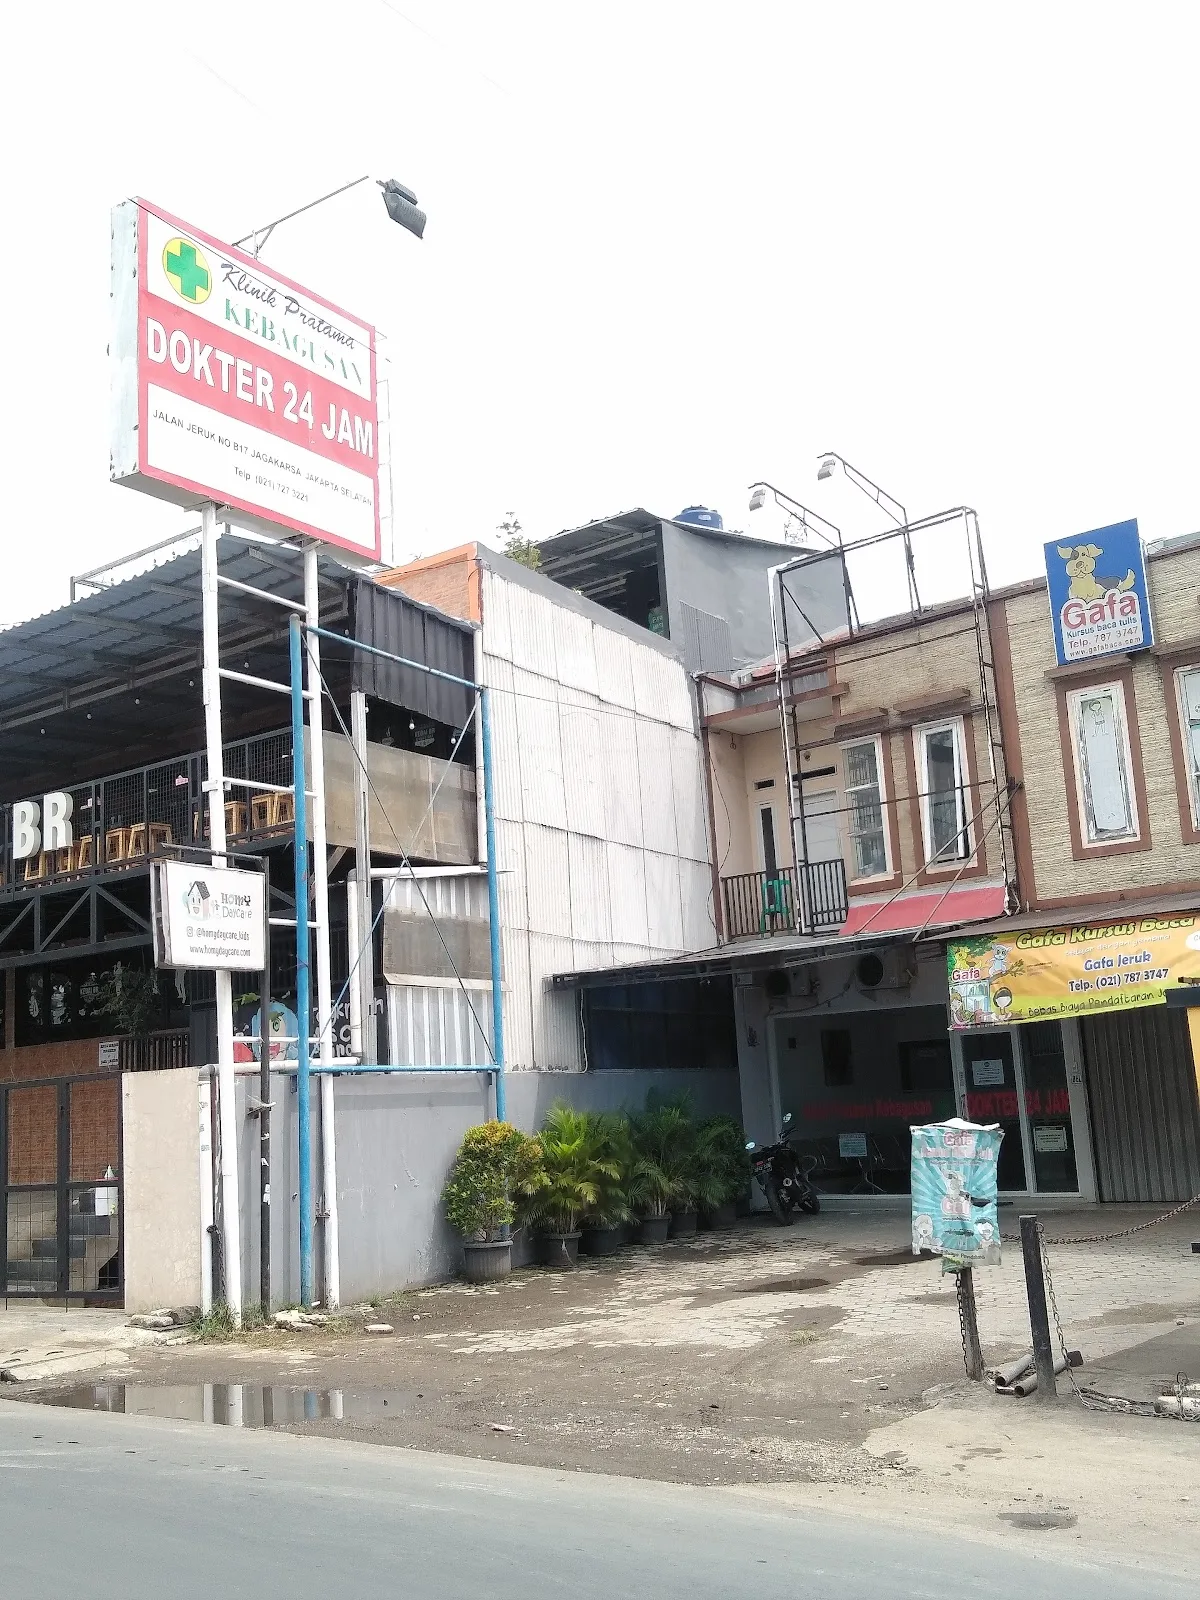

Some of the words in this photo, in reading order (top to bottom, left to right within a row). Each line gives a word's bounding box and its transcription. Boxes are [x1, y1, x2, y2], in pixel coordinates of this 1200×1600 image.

[221, 263, 276, 307] Klinik
[285, 295, 355, 349] Pratama
[225, 298, 363, 386] KEBAGUSAN
[147, 316, 275, 413] DOKTER
[283, 380, 314, 430] 24
[321, 403, 374, 459] JAM
[153, 409, 184, 428] JALAN
[186, 423, 216, 442] JERUK
[218, 436, 231, 448] NO
[233, 441, 248, 455] B17
[250, 449, 302, 476] JAGAKARSA
[304, 473, 339, 492] JAKARTA
[340, 486, 372, 506] SELATAN
[277, 482, 290, 495] 727
[292, 489, 309, 502] 3221
[1063, 593, 1137, 629] Gafa
[1067, 626, 1095, 638] Kursus
[1097, 622, 1117, 632] baca
[1119, 617, 1138, 627] tulis
[1068, 639, 1091, 650] Telp.
[1094, 632, 1112, 643] 787
[1115, 626, 1138, 638] 3747
[1069, 636, 1141, 657] www.gafabaca.com
[13, 792, 73, 859] BR
[222, 905, 252, 919] Daycare
[1016, 930, 1066, 949] Gafa
[1069, 921, 1136, 944] Kursus
[1139, 917, 1195, 932] Baca
[190, 945, 251, 958] www.homydaycare.com
[1084, 957, 1114, 971] Gafa
[1117, 951, 1151, 967] Jeruk
[952, 968, 980, 981] Gafa
[1069, 980, 1093, 992] Telp.
[1096, 974, 1121, 990] (021)
[1124, 972, 1141, 983] 787
[1144, 969, 1169, 981] 3747
[1028, 1005, 1057, 1017] Bebas
[1089, 991, 1154, 1009] Pendaftaran
